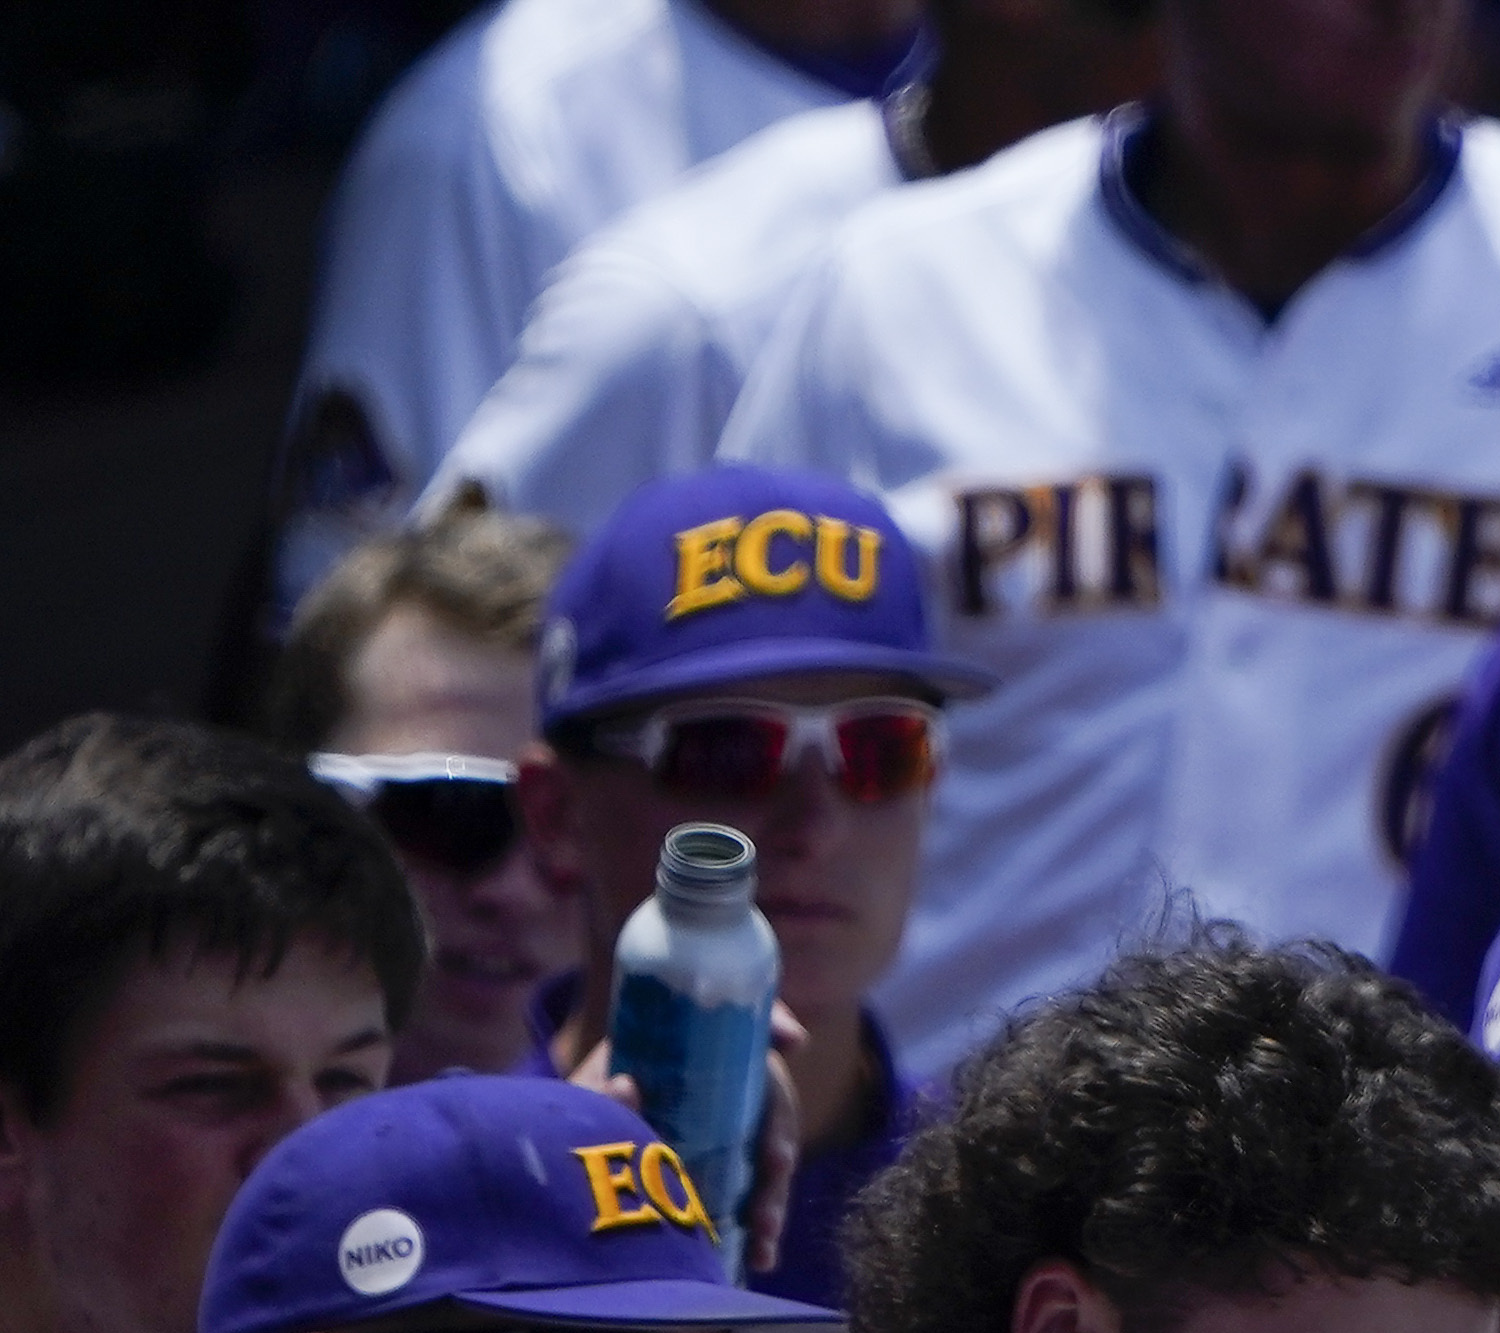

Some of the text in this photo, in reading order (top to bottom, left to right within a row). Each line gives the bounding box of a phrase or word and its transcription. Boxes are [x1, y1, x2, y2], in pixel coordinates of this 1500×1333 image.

[666, 508, 882, 620] ECU
[570, 1140, 720, 1247] EC
[345, 1236, 413, 1270] NIKO
